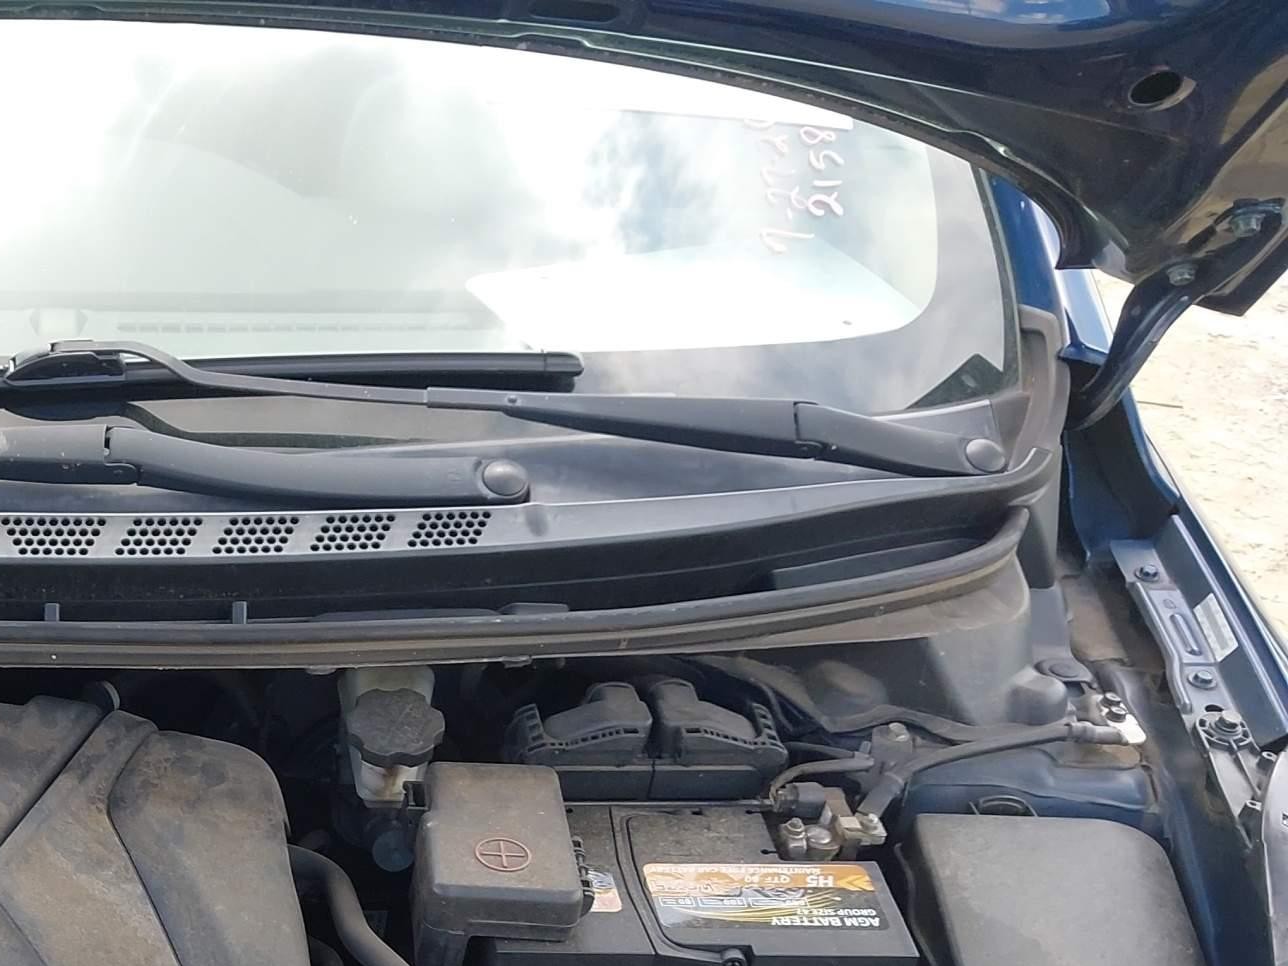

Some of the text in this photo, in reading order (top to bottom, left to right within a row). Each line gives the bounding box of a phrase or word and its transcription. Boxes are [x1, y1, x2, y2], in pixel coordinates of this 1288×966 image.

[799, 126, 845, 216] 2158
[807, 875, 834, 887] H5
[838, 908, 877, 916] GROUP
[770, 916, 881, 927] AGM BATTERY
